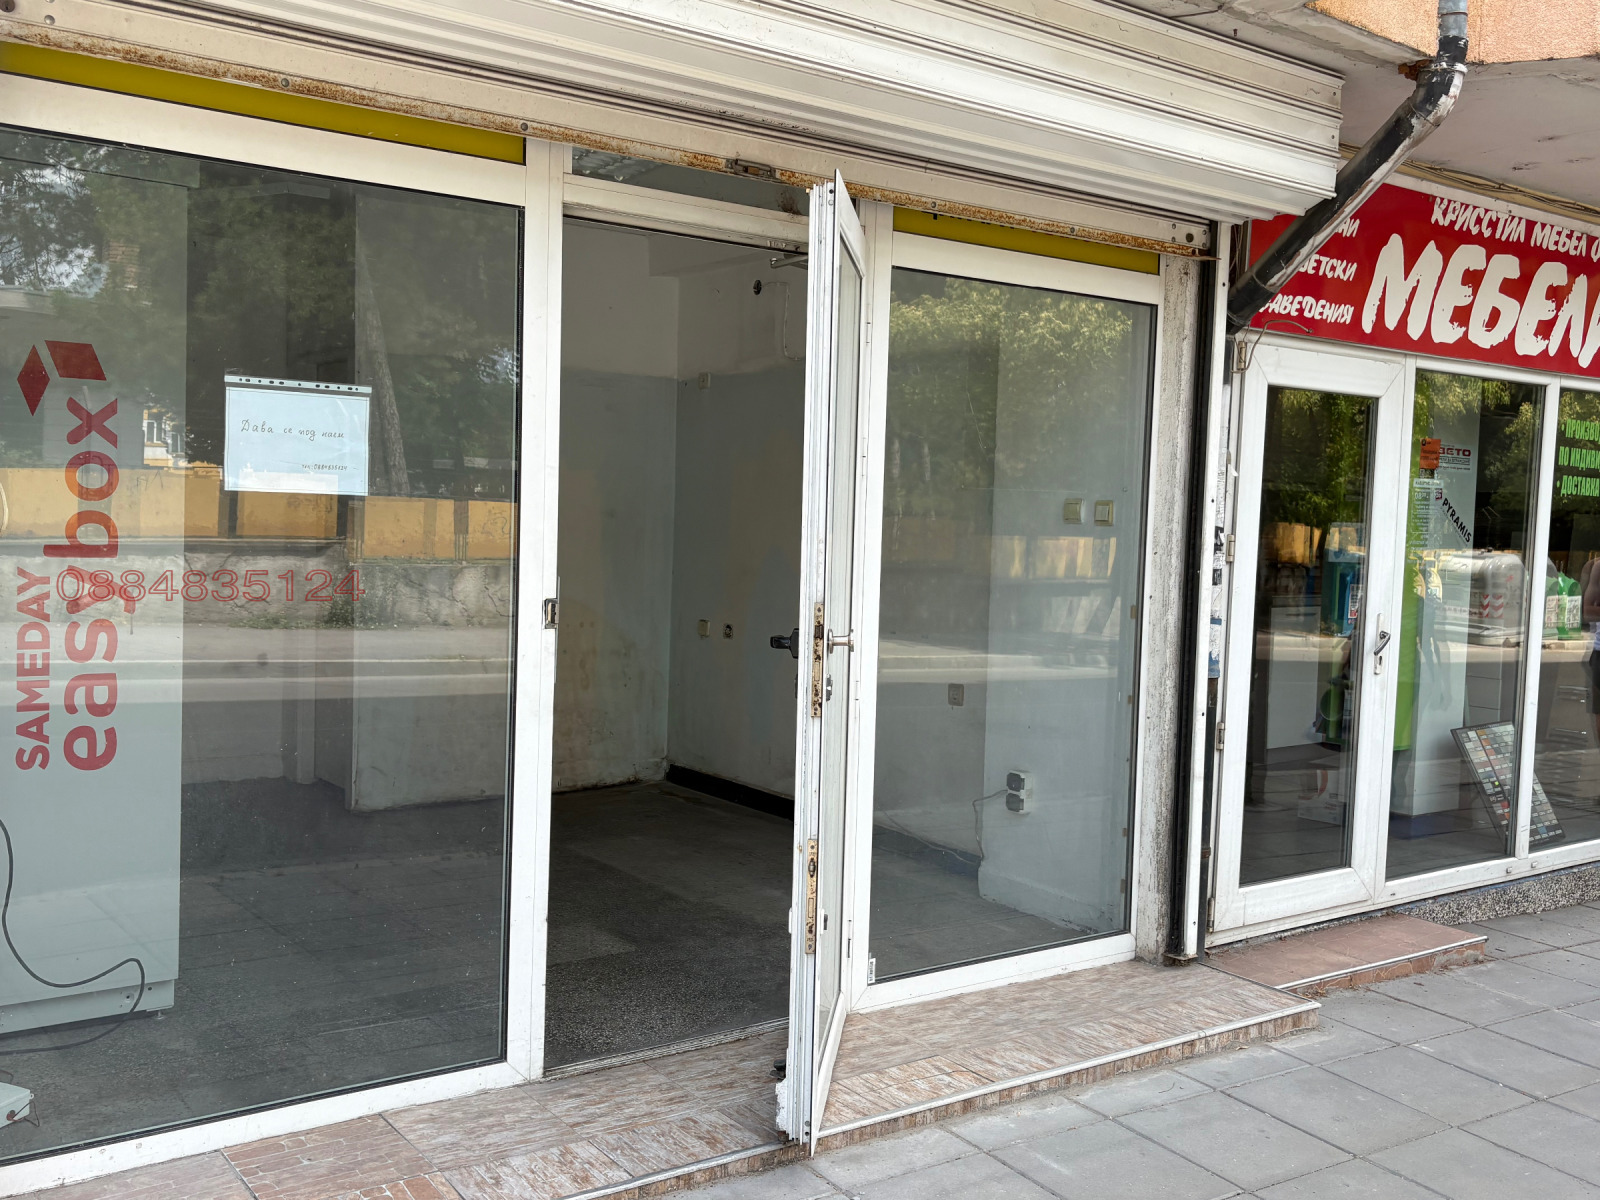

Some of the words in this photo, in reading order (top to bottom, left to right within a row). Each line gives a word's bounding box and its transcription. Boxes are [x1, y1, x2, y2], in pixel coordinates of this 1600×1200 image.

[1430, 196, 1526, 243] КРИССТИЛ
[1530, 221, 1587, 257] МЕБЕЛ
[240, 419, 274, 434] Дава
[298, 429, 316, 441] под
[1565, 418, 1600, 444] ПРОИЗВО
[1558, 446, 1570, 466] ПО
[1570, 447, 1600, 472] ИНДИВИ
[1560, 475, 1600, 497] ДОСТАВКА
[1442, 498, 1472, 543] PYRAMIS
[43, 396, 136, 771] easybox
[56, 568, 366, 602] 0884835124
[15, 566, 51, 770] SAMEDAY
